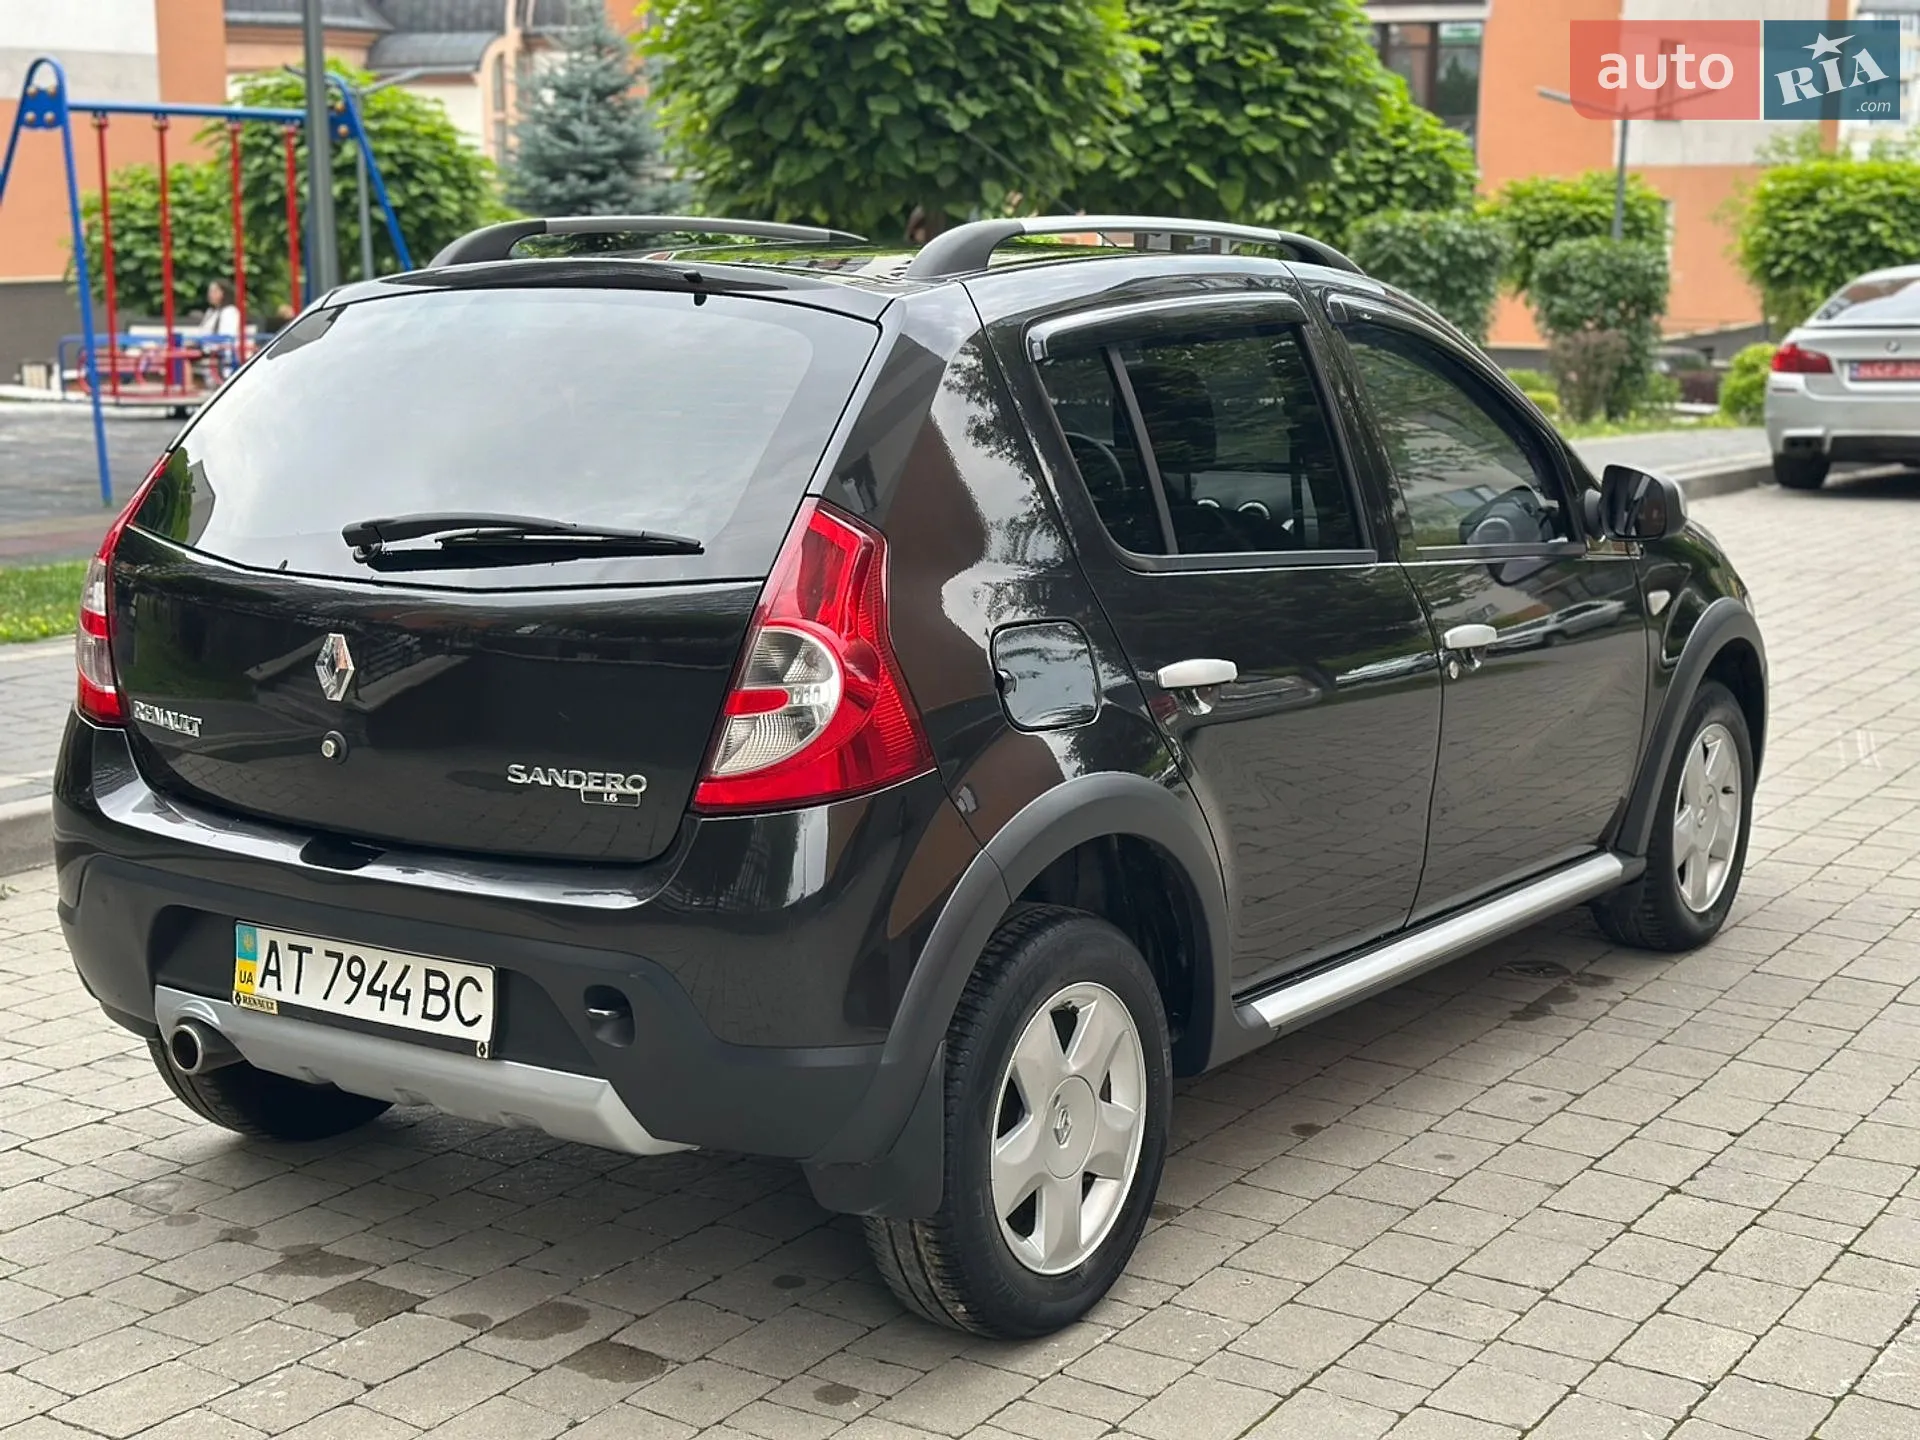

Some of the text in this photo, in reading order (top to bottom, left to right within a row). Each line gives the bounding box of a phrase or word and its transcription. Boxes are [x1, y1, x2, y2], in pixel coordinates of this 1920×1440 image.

[133, 700, 203, 738] RENAULT
[507, 764, 647, 793] SANDERO
[239, 970, 254, 985] UA
[259, 940, 483, 1028] AT 7944 BC
